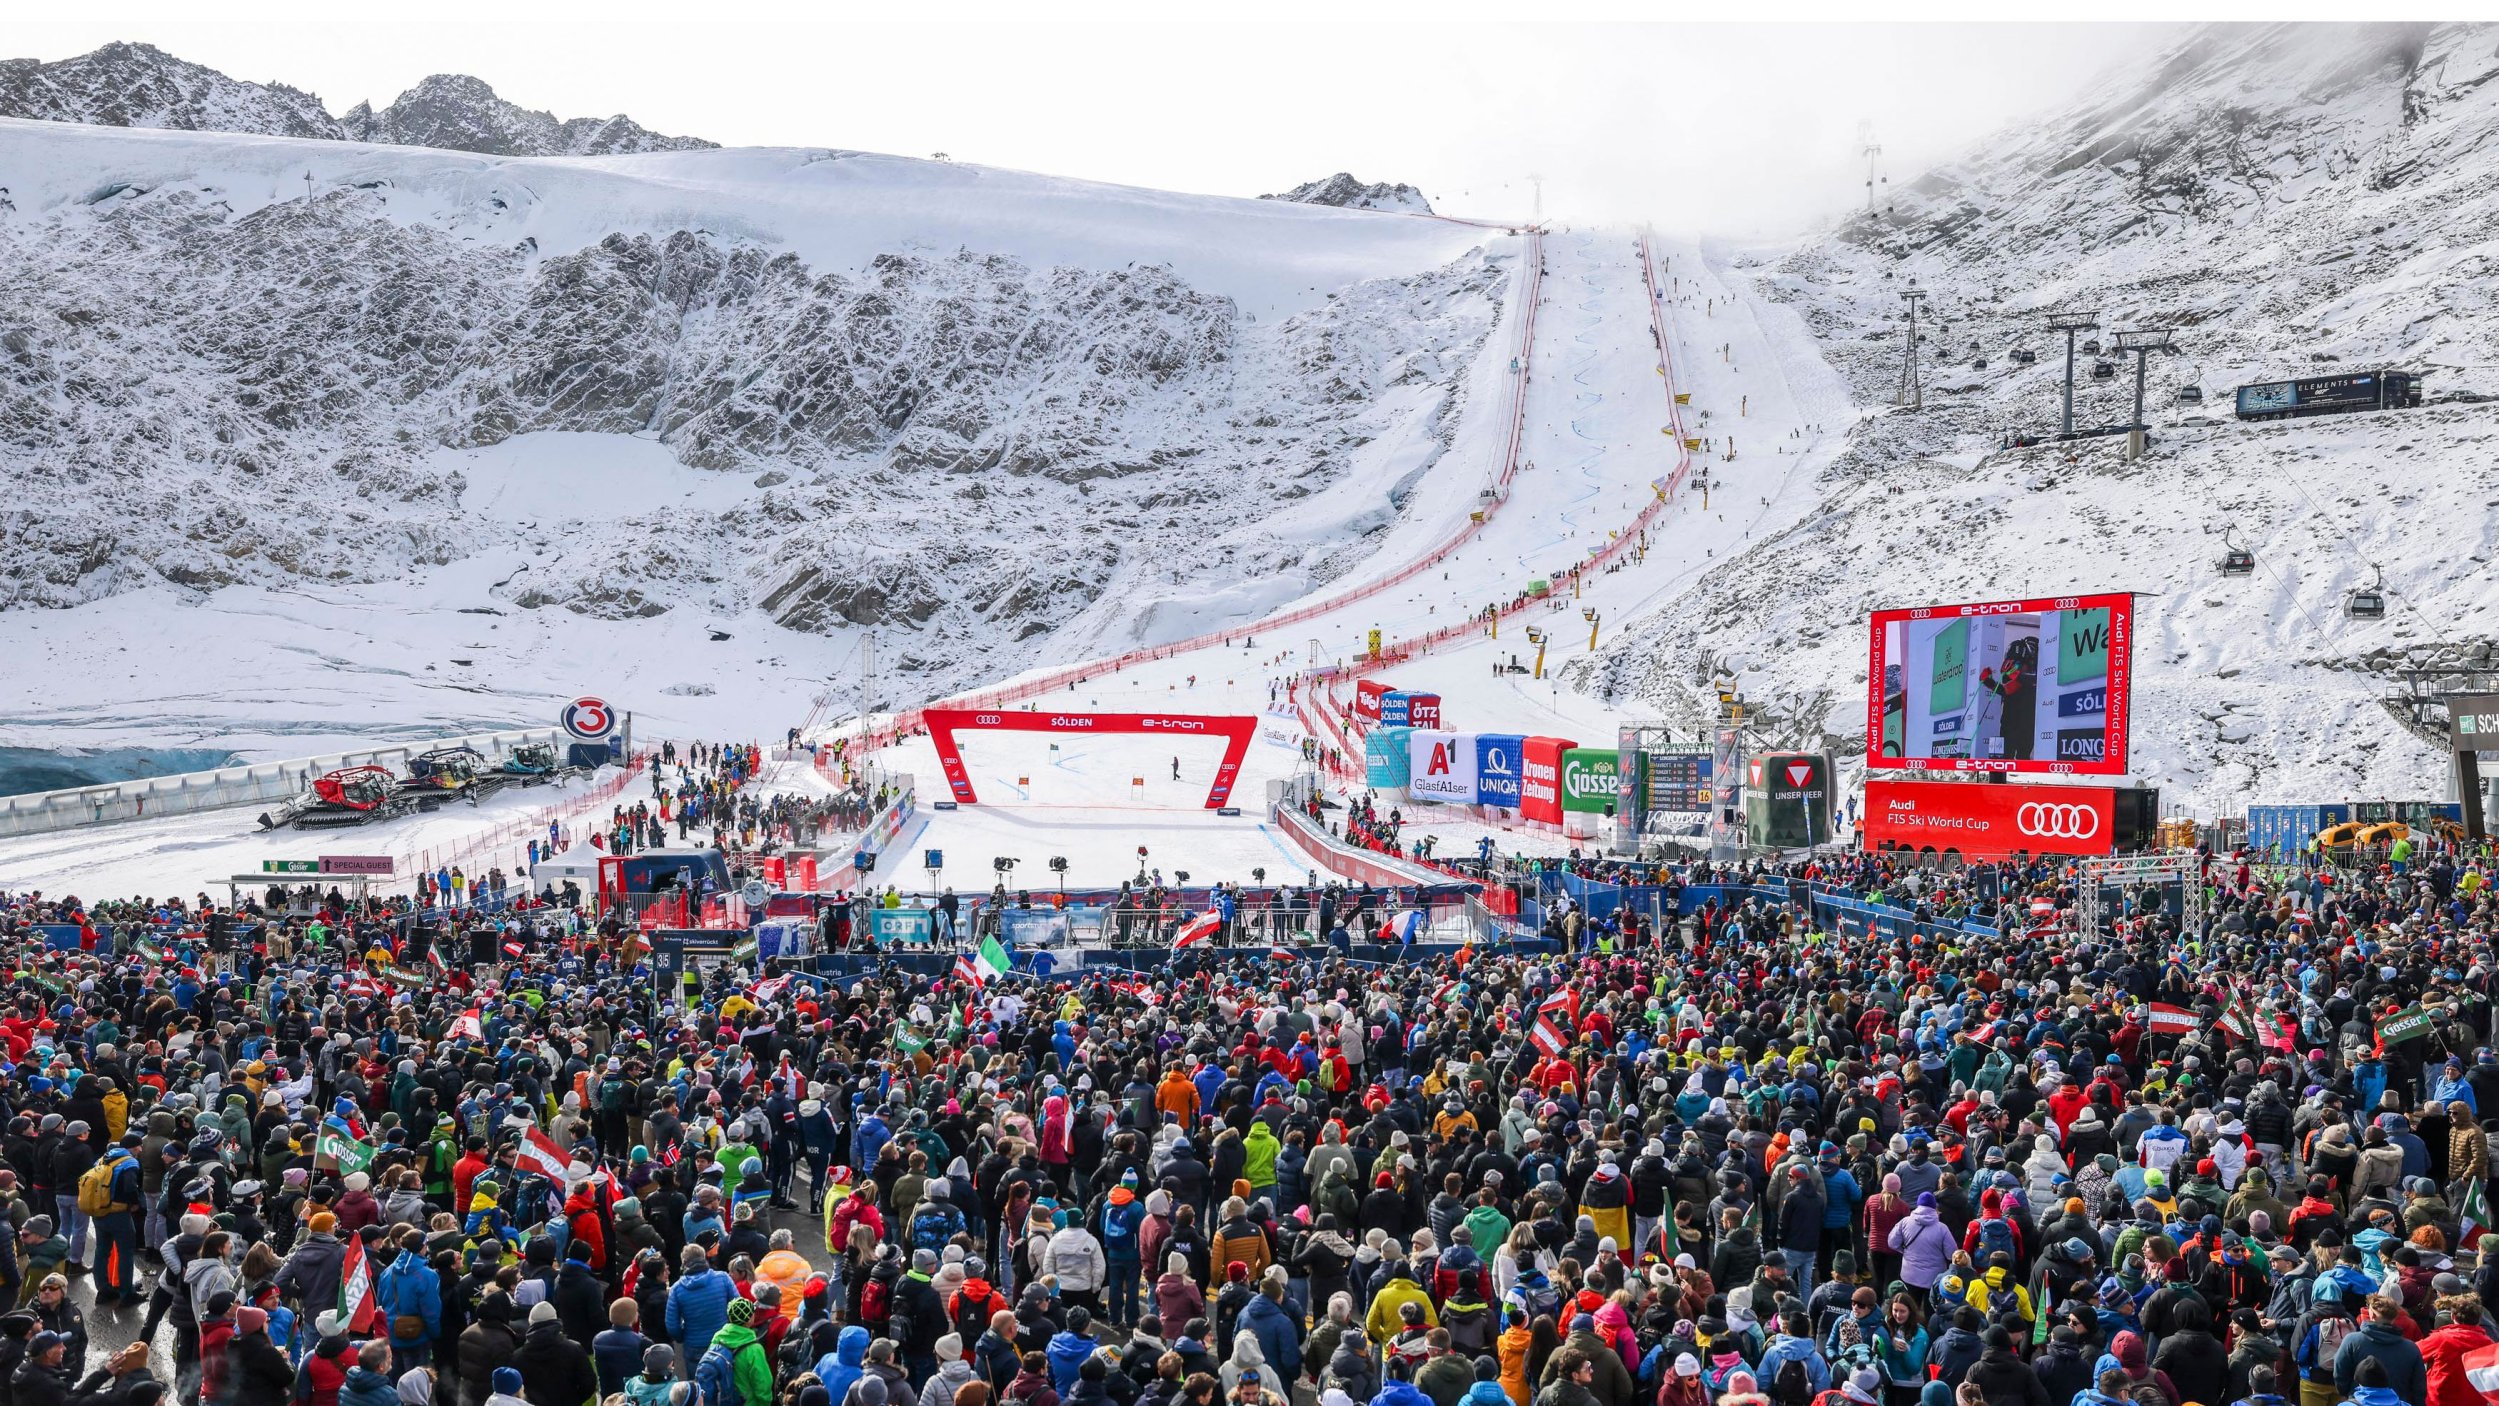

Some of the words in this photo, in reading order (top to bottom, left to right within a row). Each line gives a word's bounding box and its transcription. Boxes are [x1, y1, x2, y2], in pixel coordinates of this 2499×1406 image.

[2298, 380, 2348, 391] ELEMENTS
[2315, 388, 2327, 396] 007
[1960, 603, 2022, 615] e-tron
[2116, 613, 2124, 642] Audi
[1874, 628, 1882, 649] Cup
[2115, 646, 2123, 666] FIS
[1873, 652, 1881, 682] World
[2113, 670, 2122, 688] Ski
[1359, 691, 1380, 711] Tirol
[1381, 698, 1407, 708] SÖLDEN
[2076, 693, 2106, 712] SÖL
[2112, 690, 2122, 729] World
[1381, 711, 1407, 720] SÖLDEN
[1413, 702, 1437, 718] ÖTZ
[1051, 716, 1093, 727] SÖLDEN
[1142, 719, 1204, 730] e-tron
[1938, 720, 1955, 732] SÖLDEN
[2110, 732, 2120, 756] Cup
[1428, 738, 1456, 776] A1
[1523, 759, 1556, 781] Kronen
[1955, 761, 2016, 771] e-tron
[1415, 777, 1468, 794] GlasfA1ser
[1480, 778, 1518, 795] UNIQA
[1565, 760, 1618, 799] Gösse
[1522, 777, 1555, 804] Zeitung
[1700, 792, 1710, 802] 16
[1775, 791, 1801, 800] UNSER
[1802, 791, 1823, 799] HEER
[1889, 799, 1915, 810] Audi
[1887, 814, 1906, 824] FIS
[1908, 815, 1925, 826] Ski
[1927, 816, 1963, 828] World
[1966, 817, 1990, 832] Cup
[366, 861, 391, 869] GUEST
[658, 954, 670, 967] 35
[2384, 1015, 2422, 1036] Gösser
[324, 1133, 362, 1167] Gösser
[807, 1146, 820, 1154] NOR
